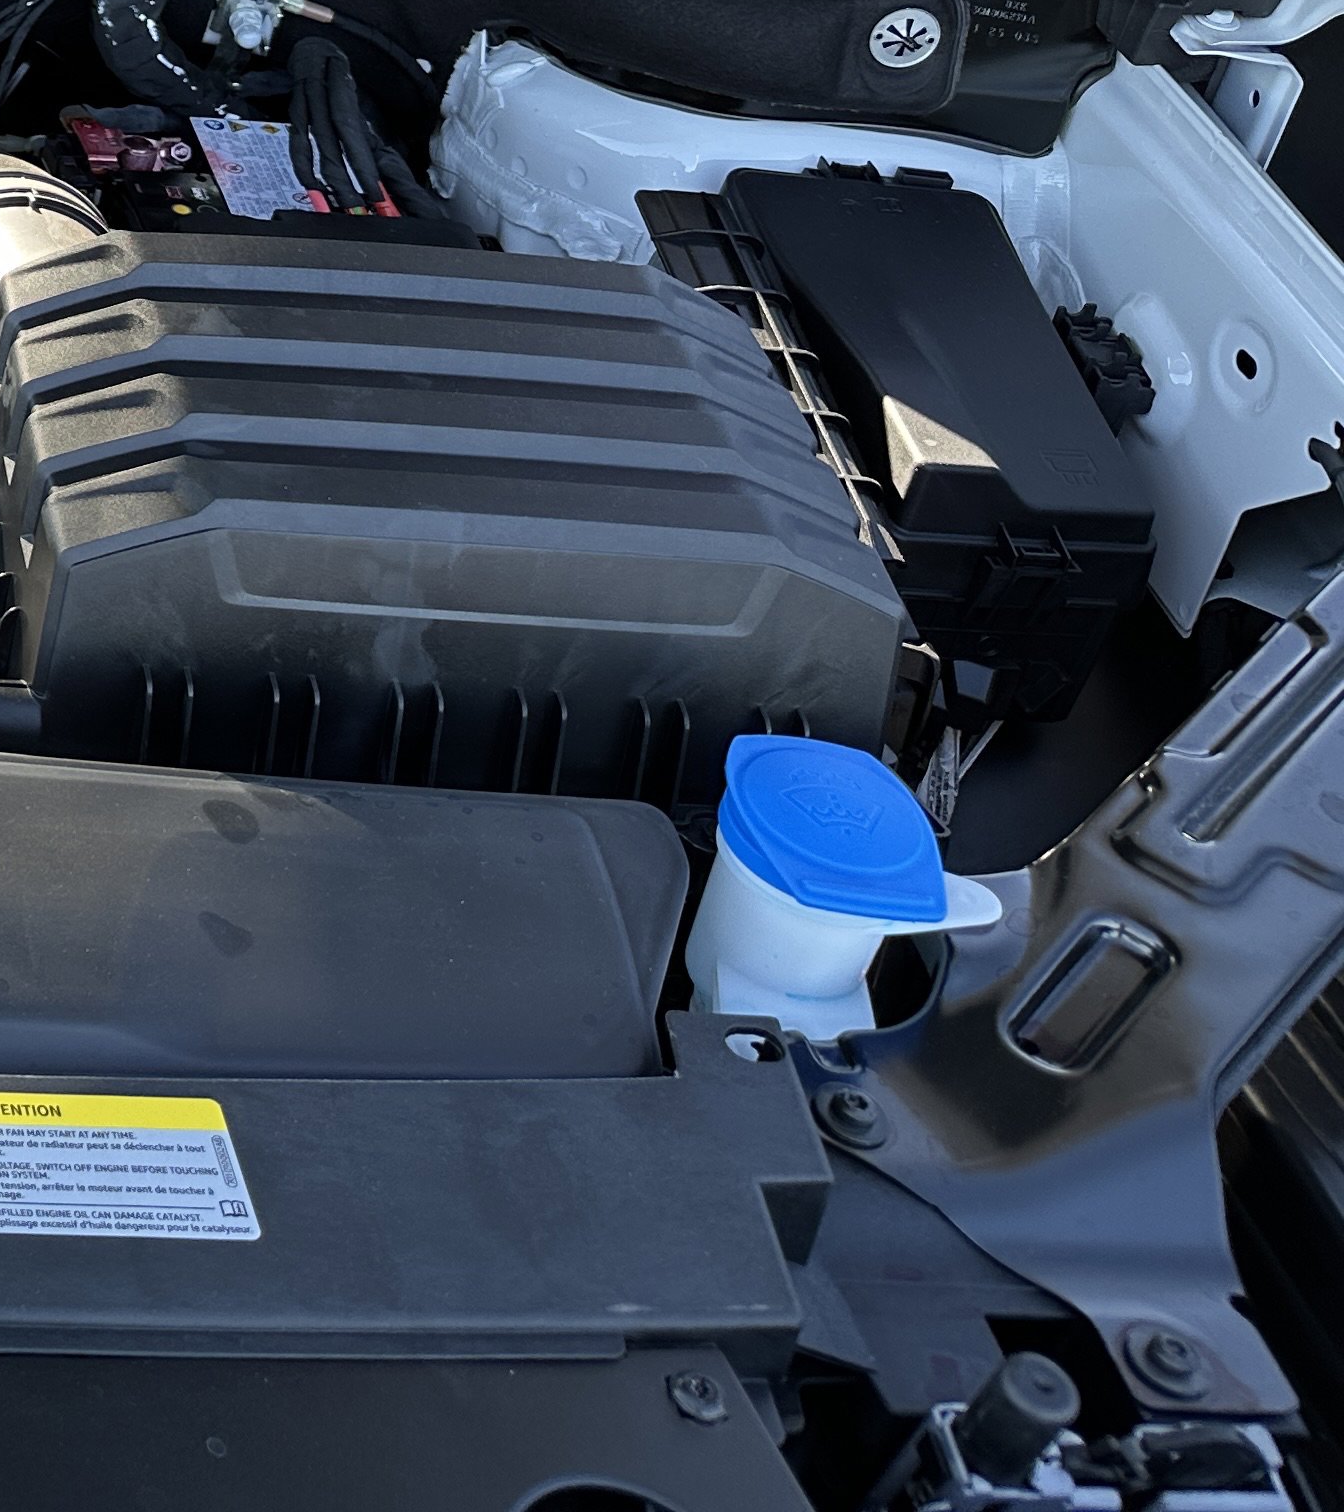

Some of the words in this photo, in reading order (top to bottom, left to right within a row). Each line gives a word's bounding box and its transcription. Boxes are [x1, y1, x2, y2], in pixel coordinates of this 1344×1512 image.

[5, 1128, 25, 1137] FAN
[26, 1128, 47, 1137] MAY
[47, 1129, 76, 1138] START
[78, 1130, 89, 1139] AT
[91, 1130, 110, 1139] ANY
[111, 1131, 137, 1140] TIME.
[26, 1139, 39, 1148] de
[40, 1140, 84, 1150] radiateur
[86, 1142, 109, 1151] peut
[122, 1141, 175, 1152] déclencher
[176, 1143, 184, 1152] à
[184, 1144, 207, 1153] tout
[10, 1170, 51, 1180] SYSTEM.
[35, 1162, 73, 1172] SWITCH
[73, 1163, 92, 1172] OFF
[93, 1164, 130, 1173] ENGINE
[130, 1164, 169, 1175] BEFORE
[168, 1166, 219, 1176] TOUCHING
[0, 1181, 41, 1192] tension,
[41, 1182, 75, 1192] arrêter
[75, 1182, 86, 1192] le
[87, 1184, 123, 1193] moteur
[125, 1185, 154, 1194] avant
[154, 1184, 168, 1194] de
[168, 1186, 206, 1196] toucher
[207, 1186, 215, 1196] à
[35, 1208, 73, 1219] ENGINE
[73, 1210, 90, 1219] OIL
[90, 1210, 112, 1220] CAN
[112, 1211, 155, 1221] DAMAGE
[39, 1219, 78, 1229] excessif
[79, 1219, 113, 1230] d'huile
[114, 1220, 166, 1232] dangereux
[166, 1224, 189, 1233] pour
[189, 1223, 201, 1233] le
